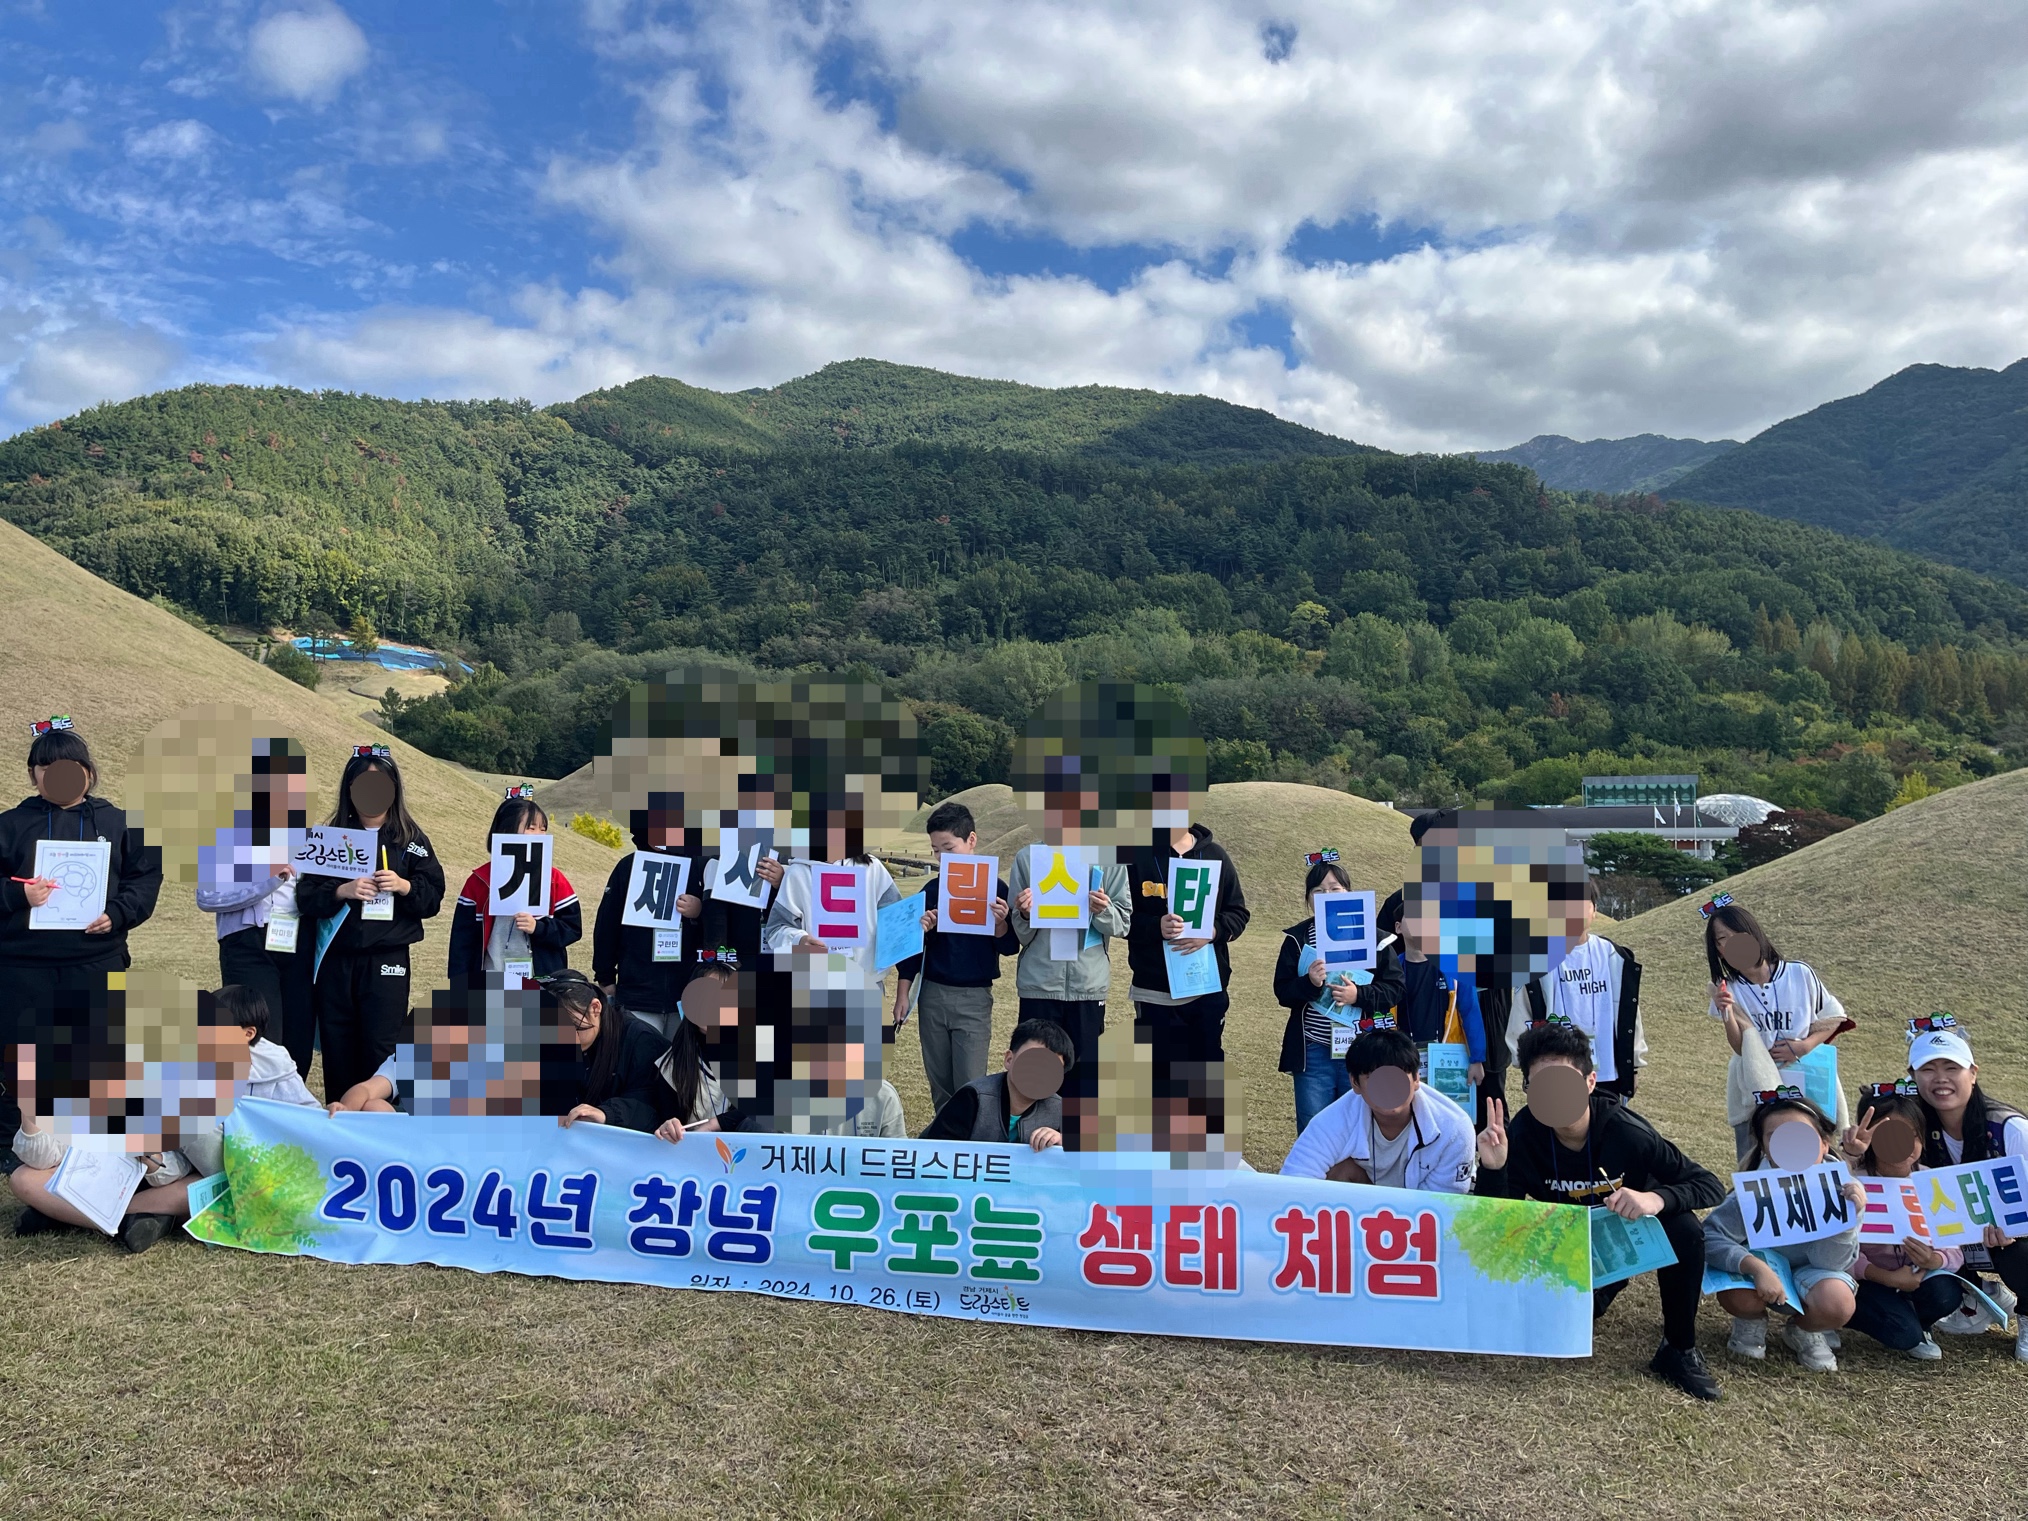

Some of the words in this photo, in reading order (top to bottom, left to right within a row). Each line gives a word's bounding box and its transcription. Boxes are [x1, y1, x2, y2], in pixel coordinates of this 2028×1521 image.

[498, 842, 543, 907] 거
[633, 860, 681, 921] 제
[818, 873, 859, 938] 드
[947, 862, 990, 926] 림
[1038, 852, 1080, 919] 스
[1173, 867, 1211, 930] 타
[1325, 898, 1367, 964] 트
[380, 964, 406, 976] Smiley
[1560, 968, 1592, 983] JUMP
[1579, 981, 1608, 995] HIGH
[760, 1145, 846, 1176] 거제시
[860, 1149, 1012, 1183] 드림스타트
[322, 1160, 598, 1250] 2024년
[628, 1176, 778, 1264] 창녕
[808, 1190, 1043, 1281] 우포늪
[1079, 1203, 1238, 1291] 생태
[1274, 1208, 1440, 1299] 체험
[1743, 1170, 1849, 1237] 거제시
[1929, 1165, 2028, 1237] 스타트
[758, 1279, 816, 1298] 2024.
[829, 1284, 858, 1303] 10.
[960, 1292, 1030, 1315] 드림스타트
